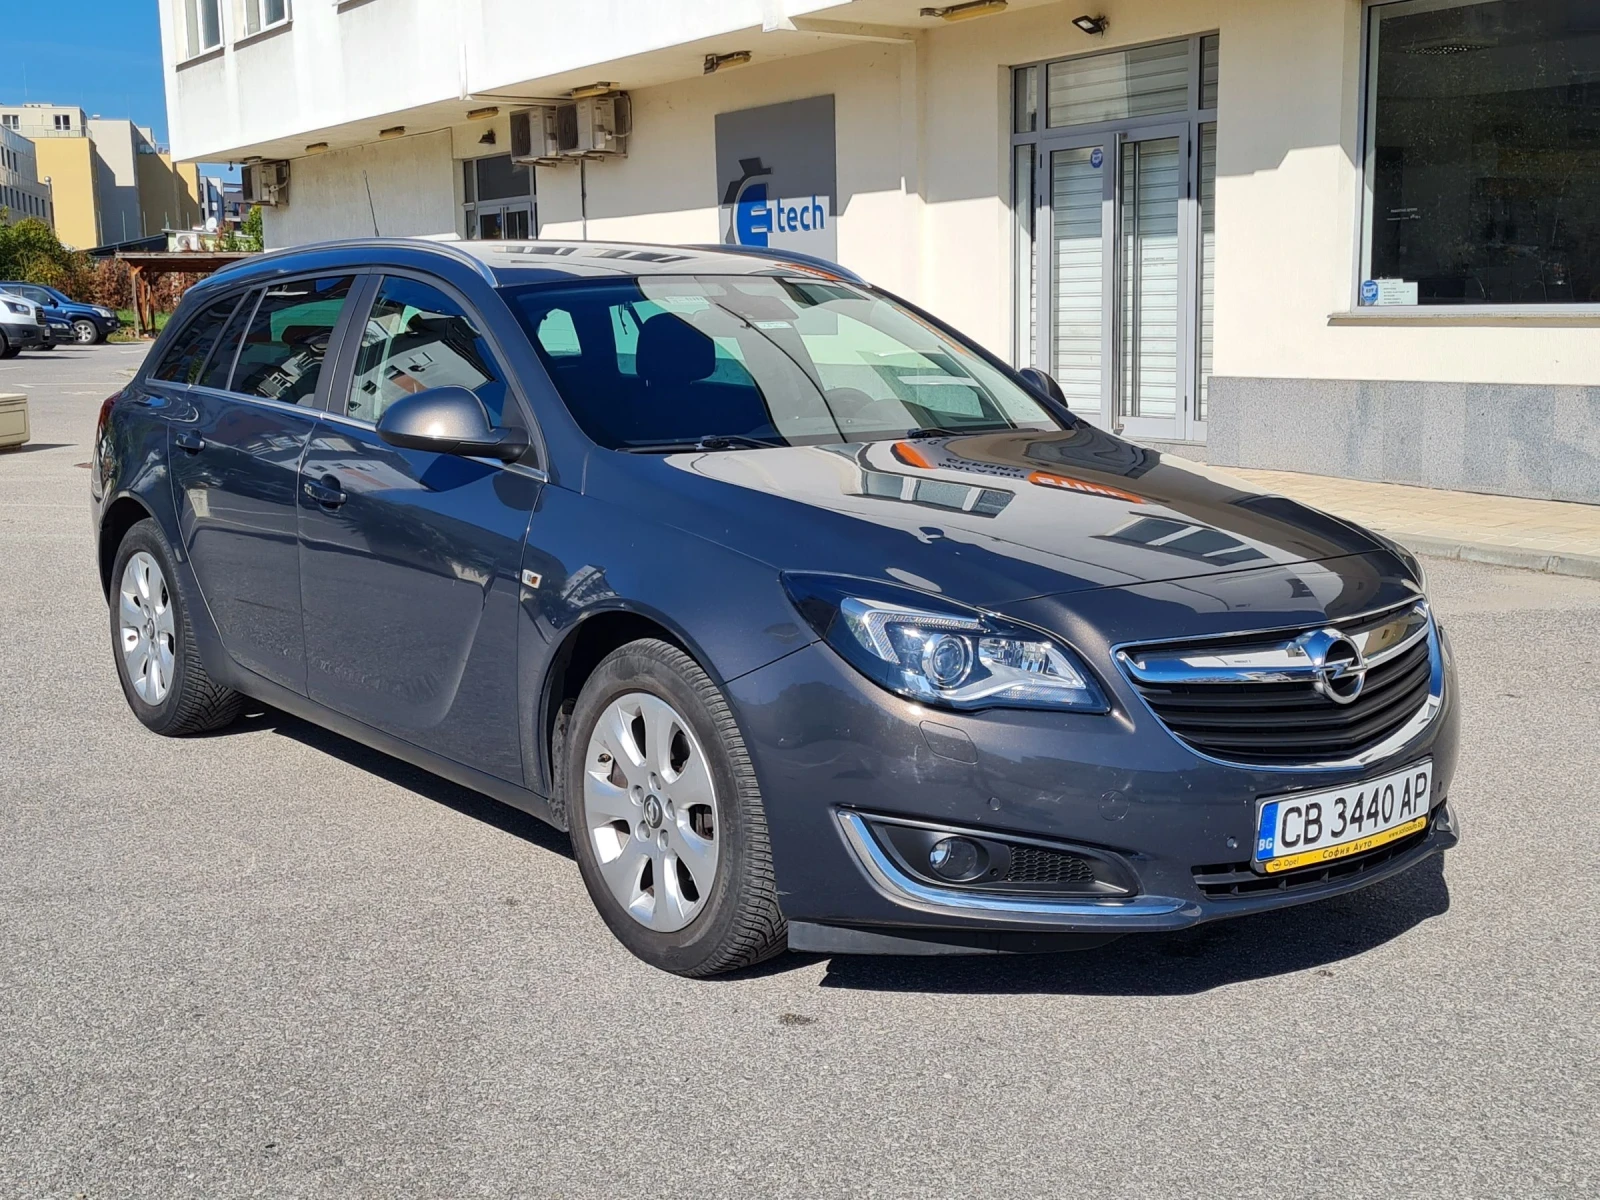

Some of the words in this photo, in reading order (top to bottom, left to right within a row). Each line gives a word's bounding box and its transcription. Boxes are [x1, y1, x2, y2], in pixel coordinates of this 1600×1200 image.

[1281, 802, 1323, 848] CB
[1331, 783, 1394, 838] 3440
[1400, 772, 1427, 819] AP
[1259, 838, 1273, 850] BG
[1322, 846, 1350, 860] София
[1353, 840, 1372, 852] Ауто
[1284, 857, 1299, 867] Opel
